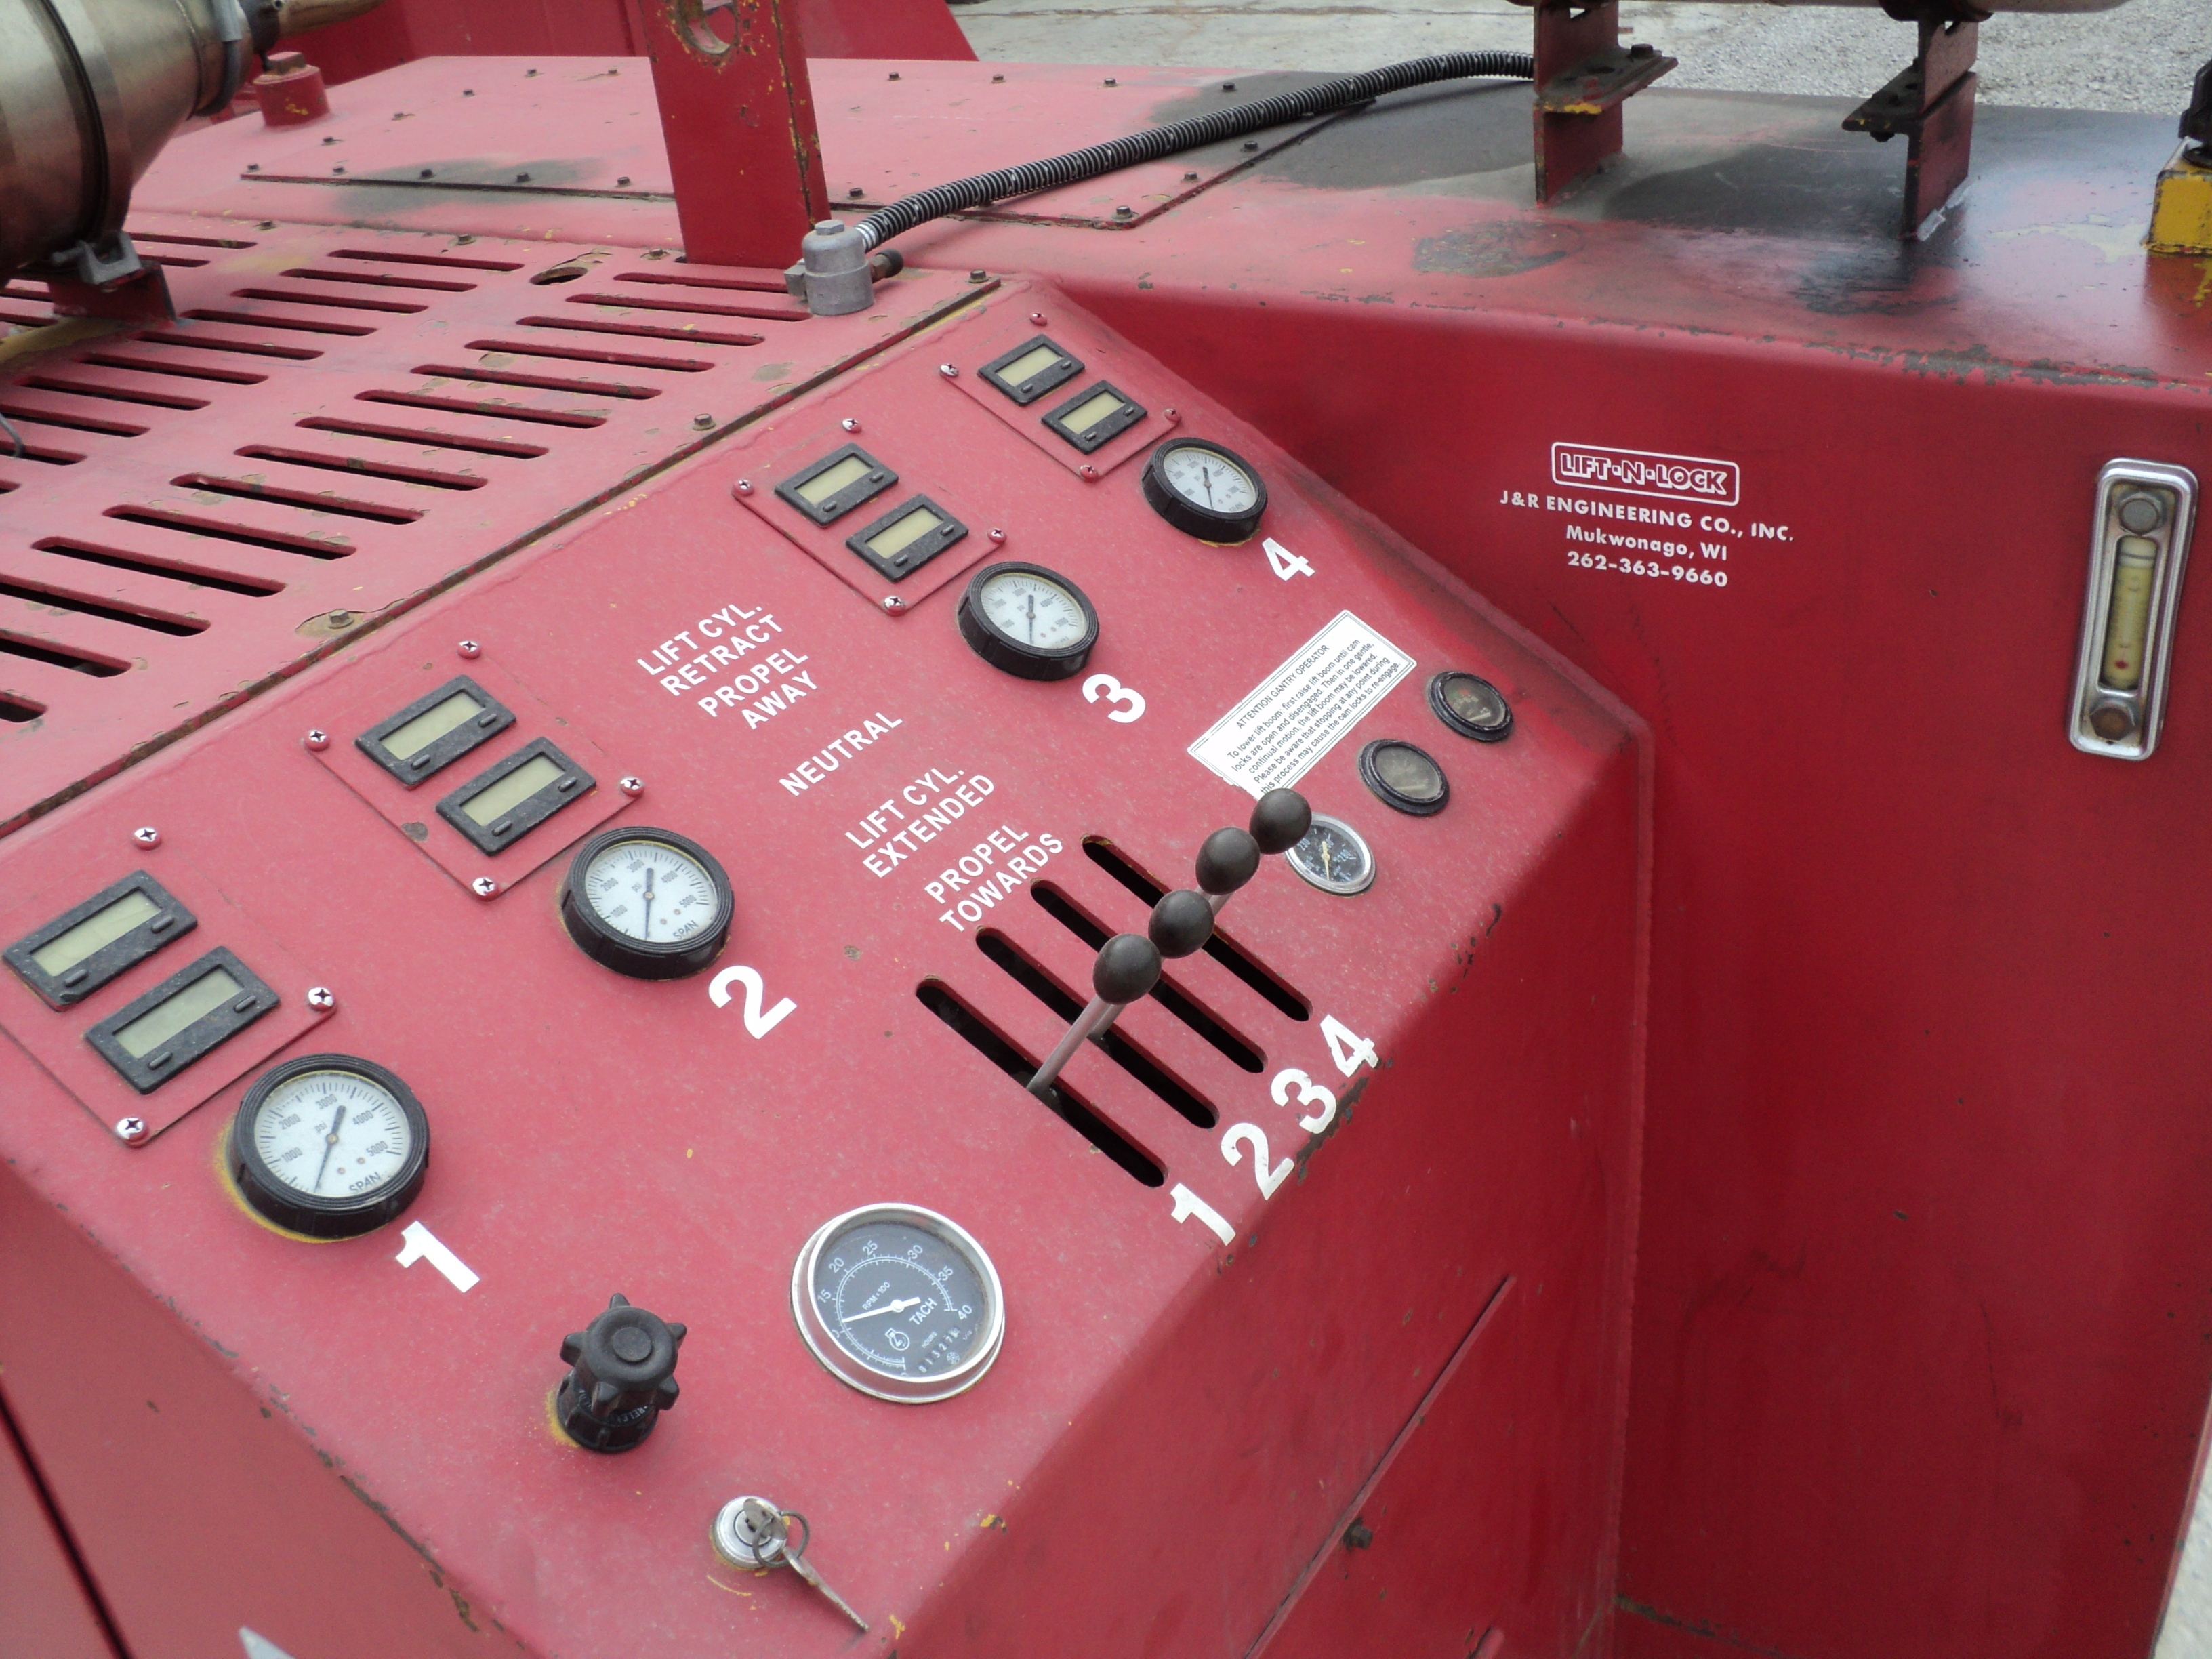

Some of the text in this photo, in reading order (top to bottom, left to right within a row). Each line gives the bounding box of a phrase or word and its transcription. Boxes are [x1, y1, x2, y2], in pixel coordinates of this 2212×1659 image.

[1500, 490, 1794, 542] J&R ENGINEERING CO., INC.
[1566, 525, 1727, 560] Mukwonago, WI
[1262, 537, 1315, 581] 4
[1568, 550, 1727, 588] 262-363-9660
[637, 602, 763, 676] LIFT CYL.
[659, 614, 783, 697] RETRACT
[697, 647, 809, 718] PROPEL
[741, 670, 818, 730] AWAY
[1082, 674, 1146, 724] 3
[1227, 750, 1240, 758] To
[1237, 734, 1256, 752] lower
[1254, 725, 1266, 735] lift
[1282, 697, 1297, 710] first
[1296, 684, 1311, 699] raise
[1308, 676, 1320, 685] lift
[1316, 662, 1336, 678] boom
[1334, 649, 1349, 663] until
[1347, 640, 1360, 651] cam
[1231, 754, 1252, 771] locks
[1250, 745, 1263, 756] are
[1261, 731, 1278, 745] open
[1277, 718, 1290, 732] and
[1321, 674, 1338, 688] Then
[1343, 658, 1355, 670] one
[1236, 644, 1330, 729] ATTENTION GANTRY OPERATOR
[1249, 745, 1278, 773] continual
[1298, 716, 1311, 726] the
[1307, 708, 1319, 718] lift
[1315, 693, 1335, 709] boom
[1334, 681, 1349, 694] may
[1344, 674, 1355, 682] be
[1254, 657, 1390, 783] Please be aware that stopping at any point during
[1260, 781, 1275, 794] this
[1273, 758, 1299, 784] process
[1298, 746, 1313, 760] may
[1311, 729, 1330, 747] cause
[1327, 720, 1340, 730] the
[1338, 708, 1352, 720] cam
[1349, 693, 1367, 710] locks
[779, 712, 903, 797] NEUTRAL
[845, 766, 965, 850] LIFT CYL.
[862, 773, 996, 879] EXTENDED
[924, 823, 1029, 905] PROPEL
[939, 832, 1064, 933] TOWARDS
[673, 920, 699, 940] SPAN
[708, 965, 798, 1040] 2
[279, 1110, 373, 1134] 2000 psi 4000
[315, 1094, 337, 1109] 3000
[1170, 1014, 1378, 1246] 1 2 3 4
[281, 1141, 388, 1162] 1000 5000
[349, 1172, 381, 1193] SPAN
[395, 1220, 480, 1293] 1
[829, 1257, 954, 1282] 20 35
[862, 1240, 923, 1260] 25 30
[817, 1289, 972, 1321] 15 40
[862, 1295, 878, 1311] RPM
[878, 1282, 890, 1294] 100
[909, 1298, 937, 1326] TACH
[922, 1331, 937, 1349] HOURS
